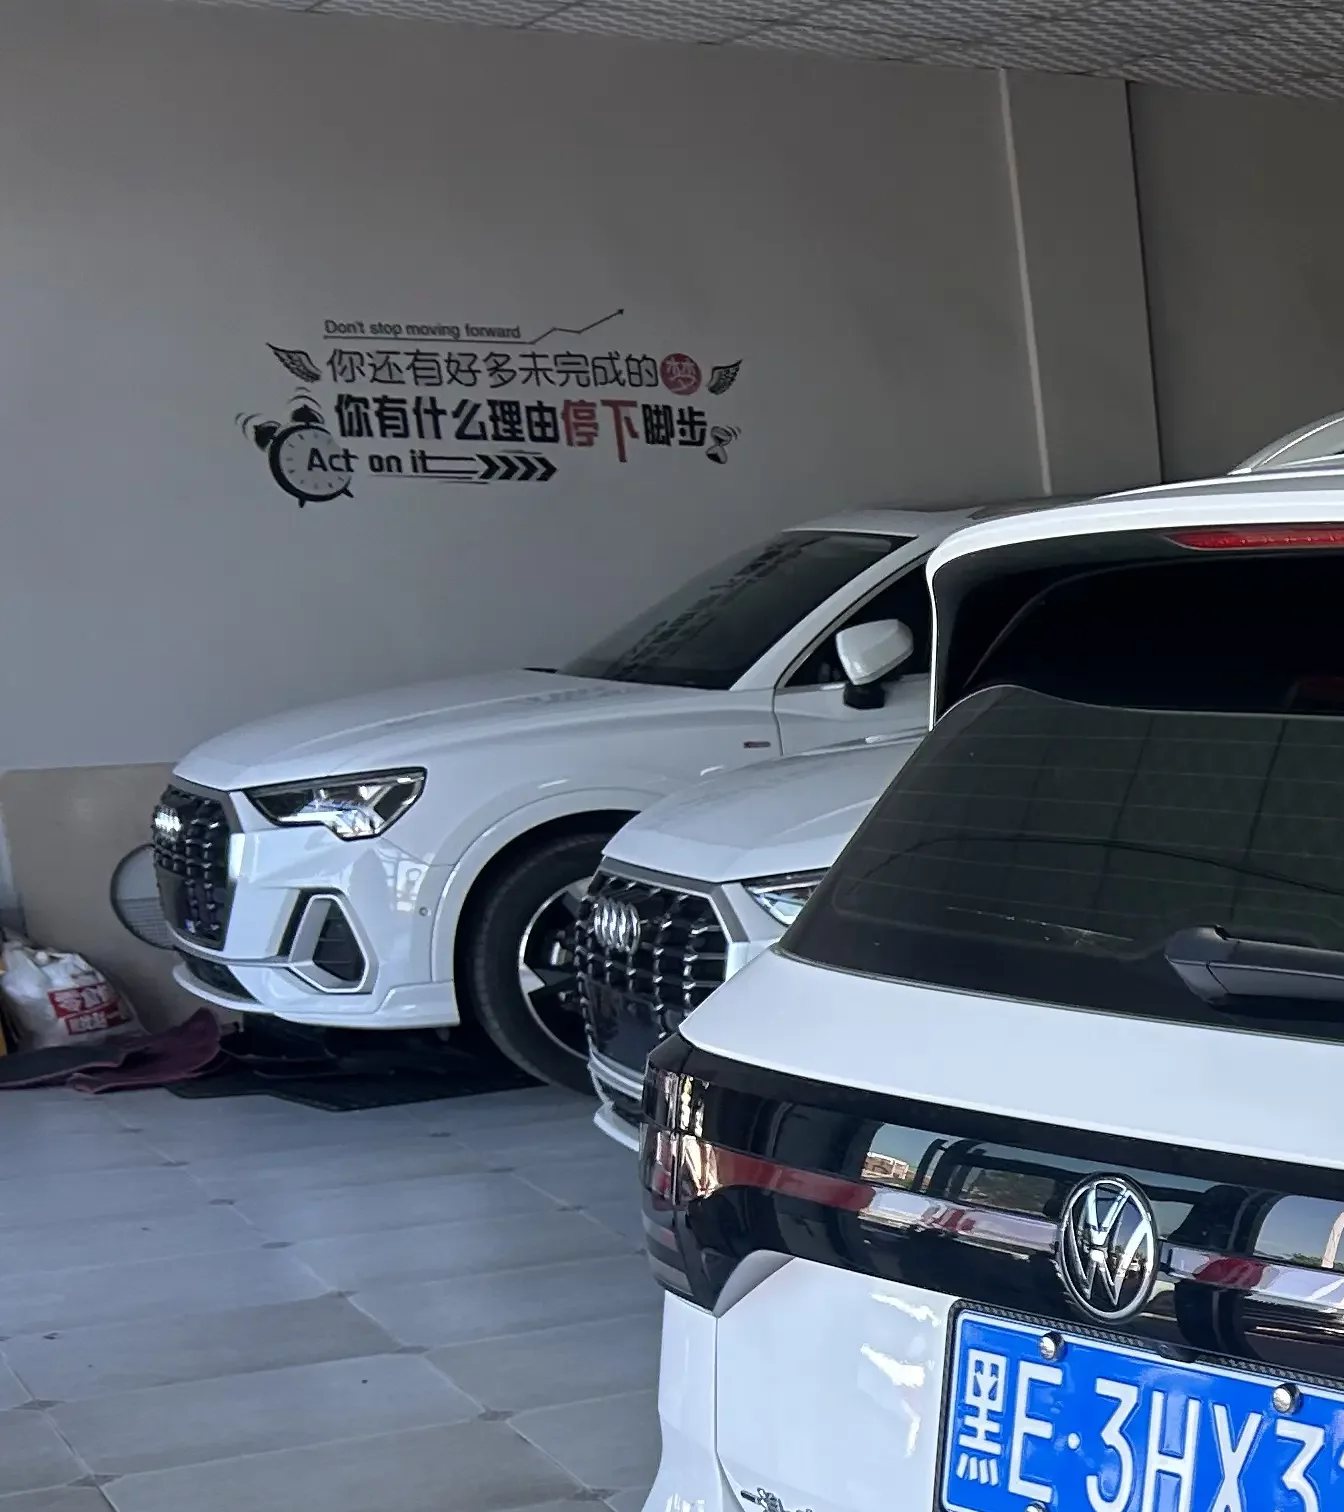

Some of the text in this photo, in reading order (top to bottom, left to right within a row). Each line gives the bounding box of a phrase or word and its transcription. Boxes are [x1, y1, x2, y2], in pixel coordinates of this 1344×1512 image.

[323, 318, 521, 340] Don't stop moving forward
[334, 393, 707, 463] 你有什么理由停下脚步
[307, 447, 429, 474] Act on it
